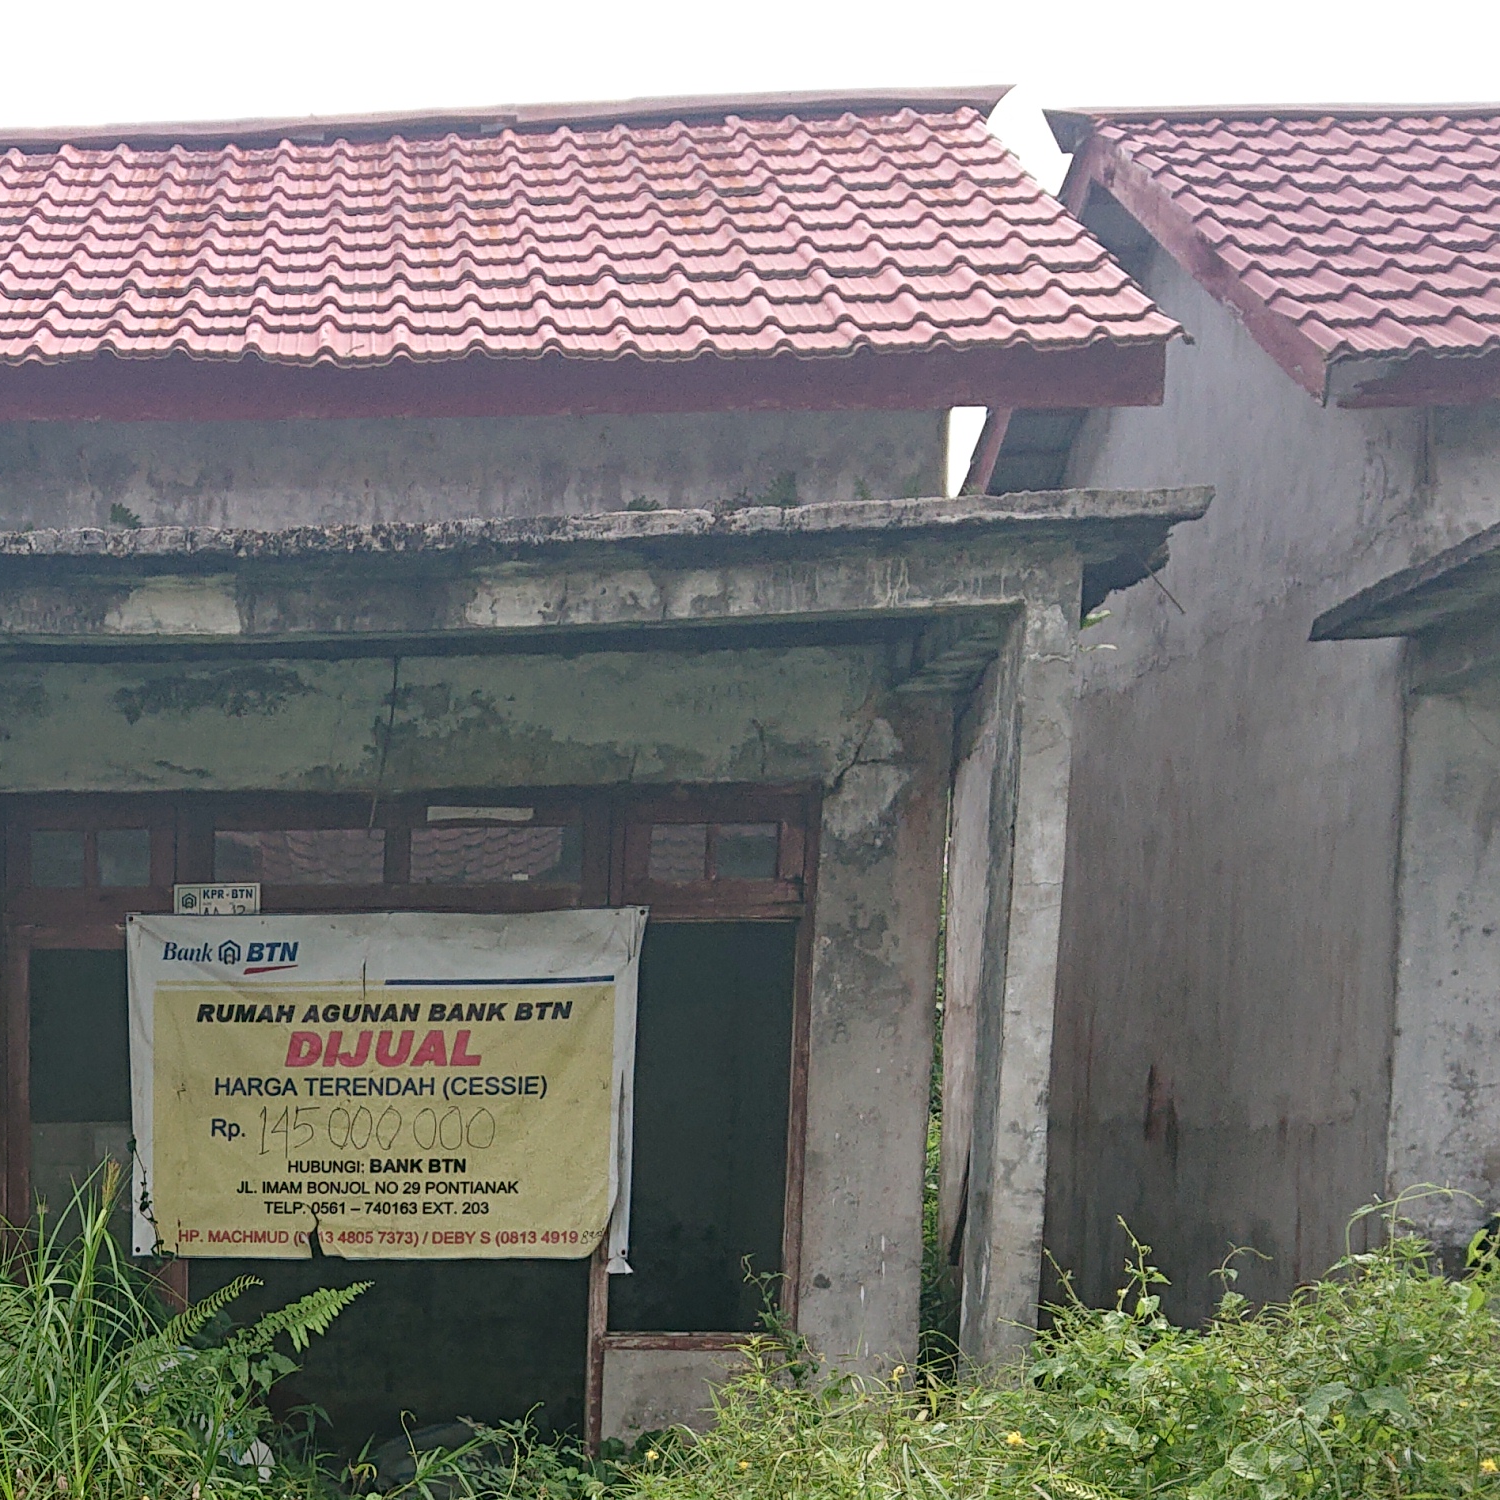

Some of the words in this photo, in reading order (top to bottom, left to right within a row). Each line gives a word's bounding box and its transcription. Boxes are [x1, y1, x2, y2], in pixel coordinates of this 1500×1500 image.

[162, 941, 214, 962] Bank
[246, 941, 299, 962] BTN
[196, 1003, 295, 1024] RUMAH
[301, 1003, 420, 1023] AGUNAN
[427, 1002, 507, 1022] BANK
[514, 1001, 573, 1022] BTN
[284, 1029, 482, 1068] DIJUAL
[214, 1077, 298, 1098] HARGA
[304, 1077, 436, 1098] TERENDAH
[442, 1075, 548, 1100] (CESSIE)
[211, 1118, 246, 1142] Rp.
[287, 1160, 365, 1174] HUBUNGI:
[369, 1158, 423, 1174] BANK
[428, 1158, 467, 1173] BTN
[236, 1181, 257, 1195] JL.
[261, 1181, 301, 1195] IMAM
[306, 1181, 370, 1195] BONJOL
[375, 1181, 399, 1195] NO
[402, 1181, 421, 1195] 29
[425, 1181, 520, 1195] PONTIANAK
[264, 1201, 306, 1215] TELP.
[310, 1201, 346, 1215] 0561
[363, 1201, 418, 1215] 740163
[422, 1201, 457, 1215] EXT.
[461, 1201, 490, 1215] 203
[178, 1229, 203, 1243] HP.
[207, 1230, 289, 1244] MACHMUD
[337, 1230, 374, 1244] 4805
[378, 1230, 419, 1248] 7373)
[431, 1230, 476, 1244] DEBY
[479, 1230, 491, 1244] S
[495, 1230, 537, 1248] (0813
[540, 1230, 579, 1244] 4919
